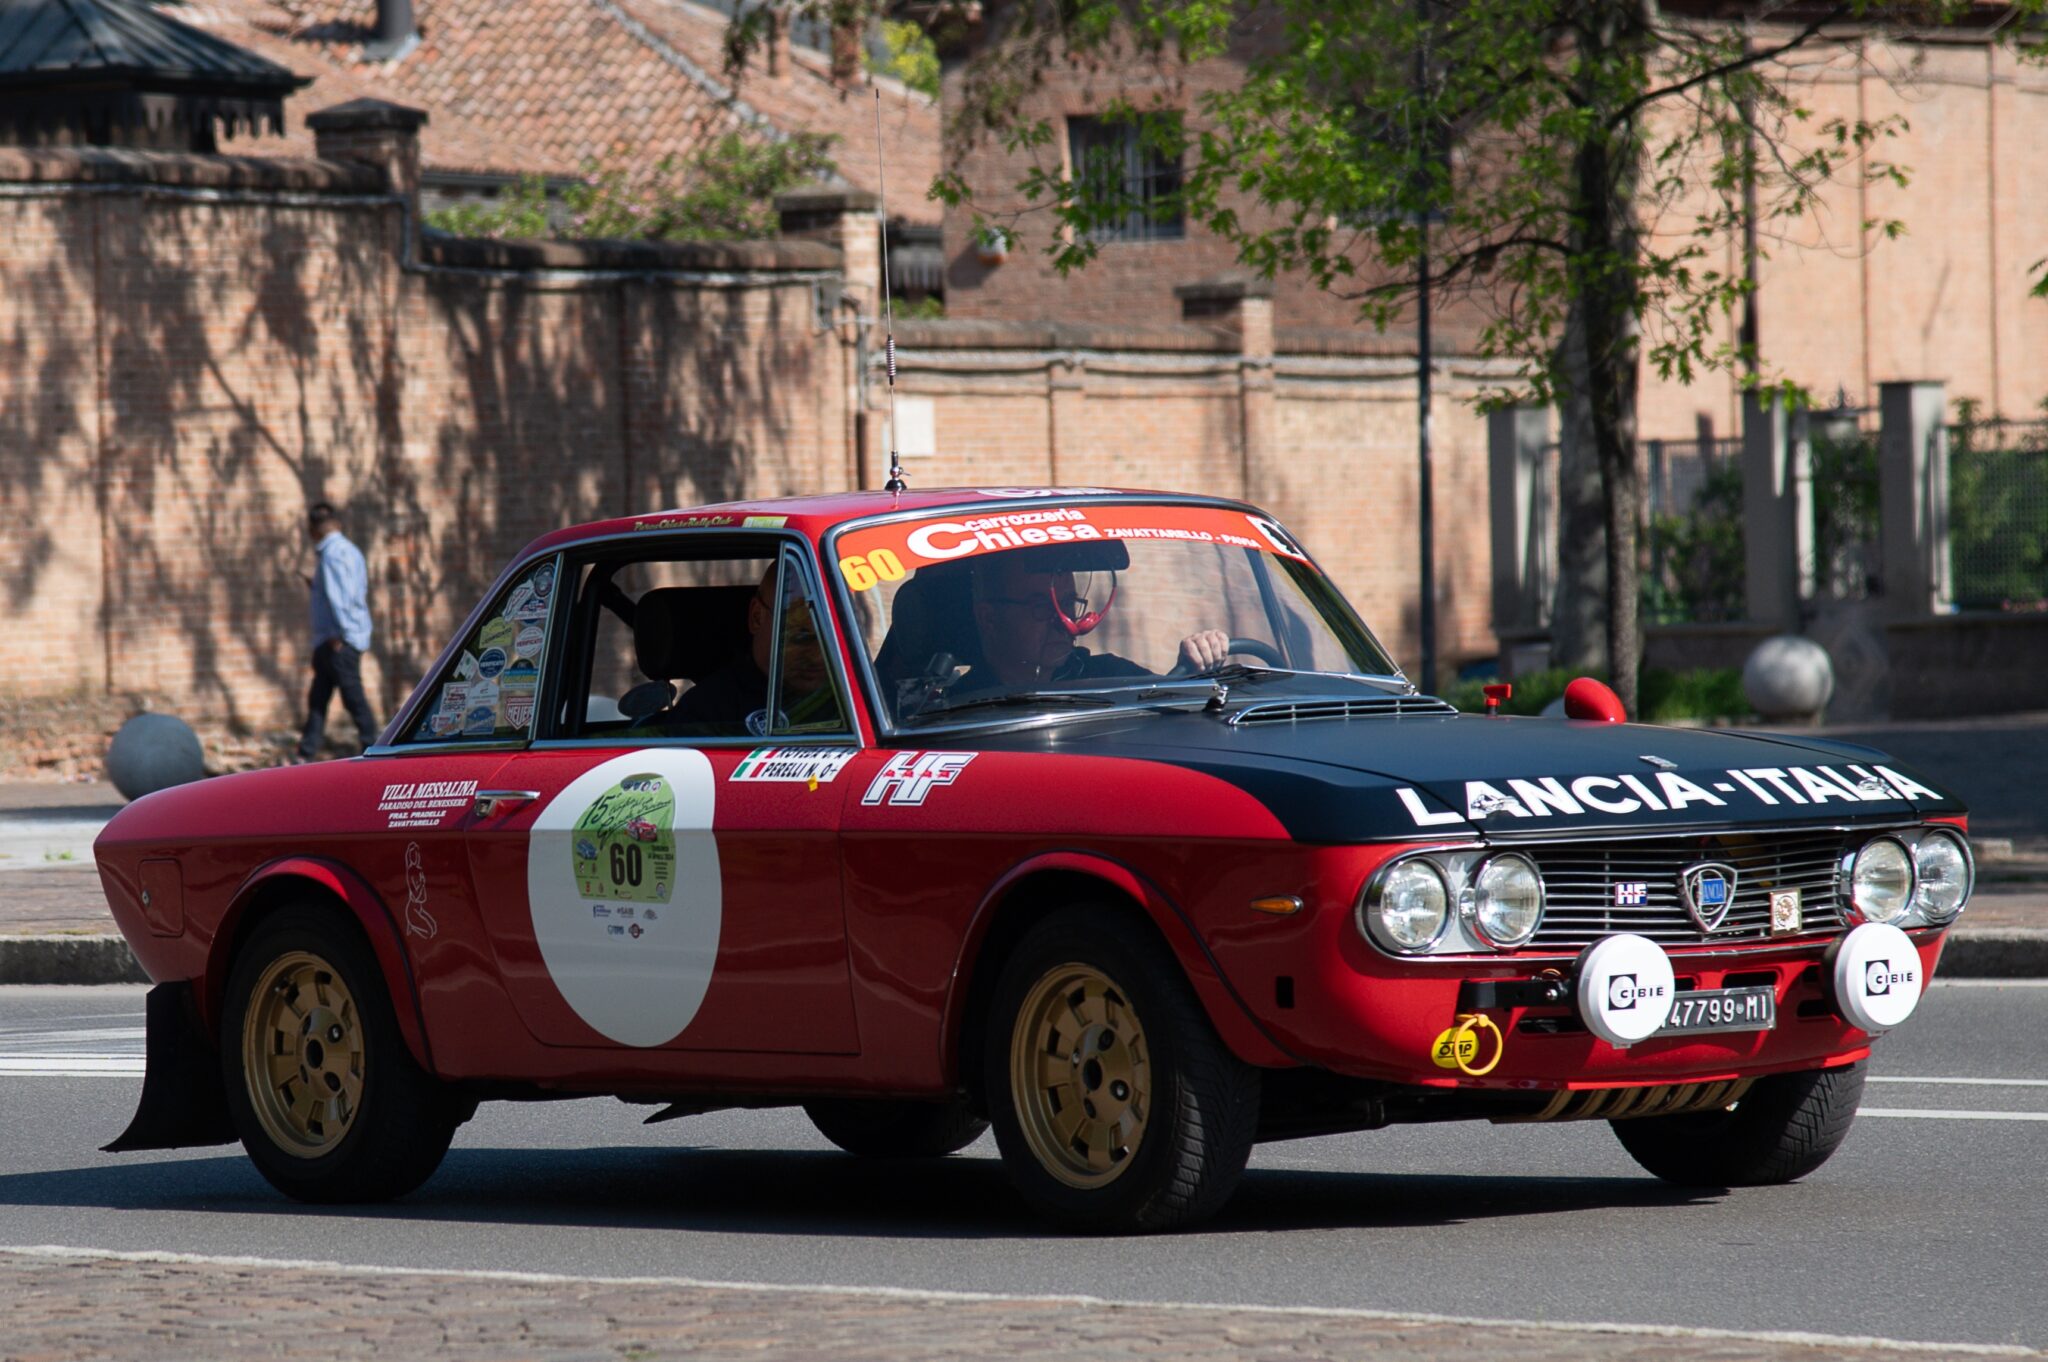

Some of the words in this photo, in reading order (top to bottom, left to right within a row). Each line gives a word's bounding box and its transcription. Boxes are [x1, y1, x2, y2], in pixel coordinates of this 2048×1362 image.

[967, 508, 1085, 532] carrozzeria
[906, 521, 1104, 560] Chiesa
[1103, 527, 1214, 543] ZAVATTARELLO
[1220, 534, 1263, 548] PAVIA
[838, 548, 907, 593] 60
[763, 762, 803, 779] PERELLI
[861, 752, 979, 806] HF
[382, 783, 416, 801] VILLA
[413, 780, 479, 799] MESSALINA
[378, 801, 414, 811] PARADISO
[413, 800, 428, 809] DEL
[427, 798, 468, 808] BENESSERE
[409, 810, 447, 819] PRADELLE
[388, 819, 440, 829] ZAVATTARELLO
[610, 842, 643, 887] 60
[1617, 883, 1647, 905] HF
[1661, 999, 1735, 1028] 47799
[1745, 994, 1767, 1020] MI
